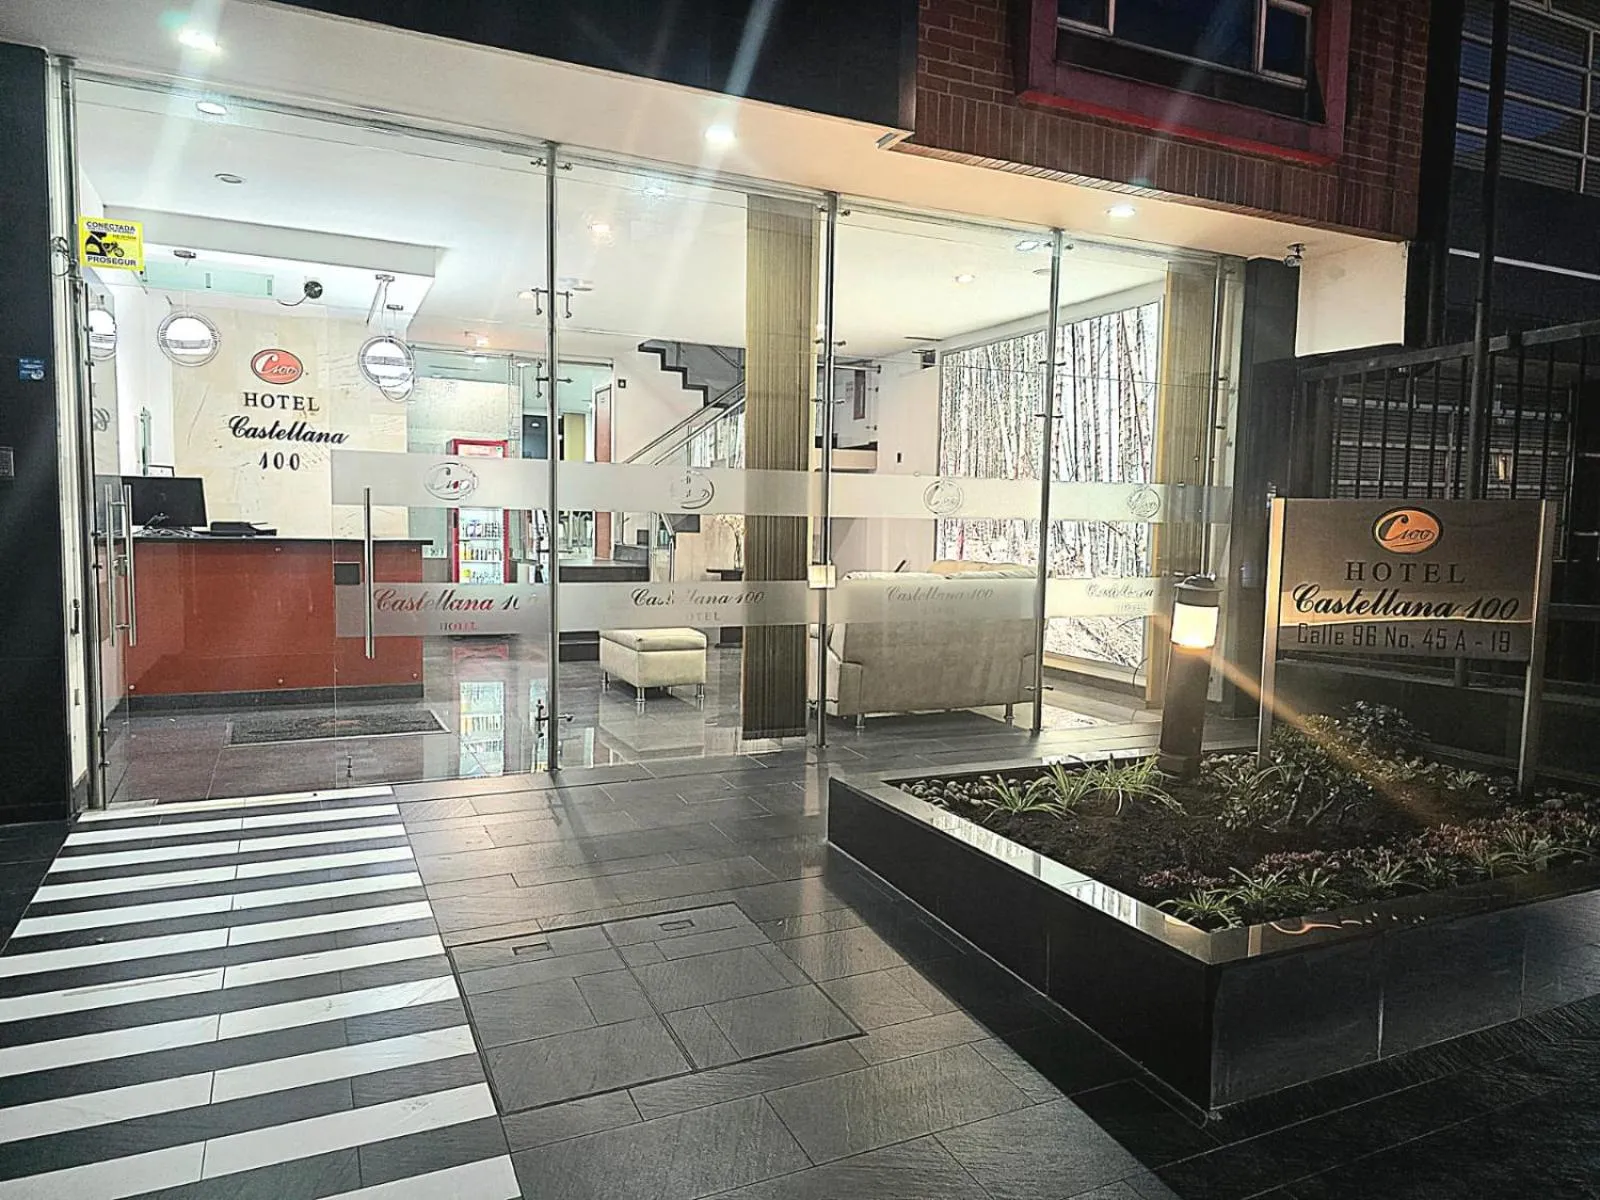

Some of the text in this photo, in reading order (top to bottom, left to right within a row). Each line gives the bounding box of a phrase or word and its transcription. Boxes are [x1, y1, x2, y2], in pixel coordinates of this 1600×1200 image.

[86, 221, 136, 231] CONECTADA
[87, 255, 137, 266] PROSEGUR
[243, 392, 320, 411] HOTEL
[228, 415, 349, 444] Castellana
[259, 451, 300, 471] 100
[1344, 561, 1466, 584] HOTEL
[373, 588, 494, 613] Castellana
[1292, 583, 1520, 620] Castellana 100
[1297, 622, 1345, 647] Calle
[1352, 624, 1378, 647] 96
[1384, 625, 1415, 649] No.
[1422, 627, 1448, 651] 45
[1455, 629, 1466, 652] A
[1491, 630, 1512, 653] 19
